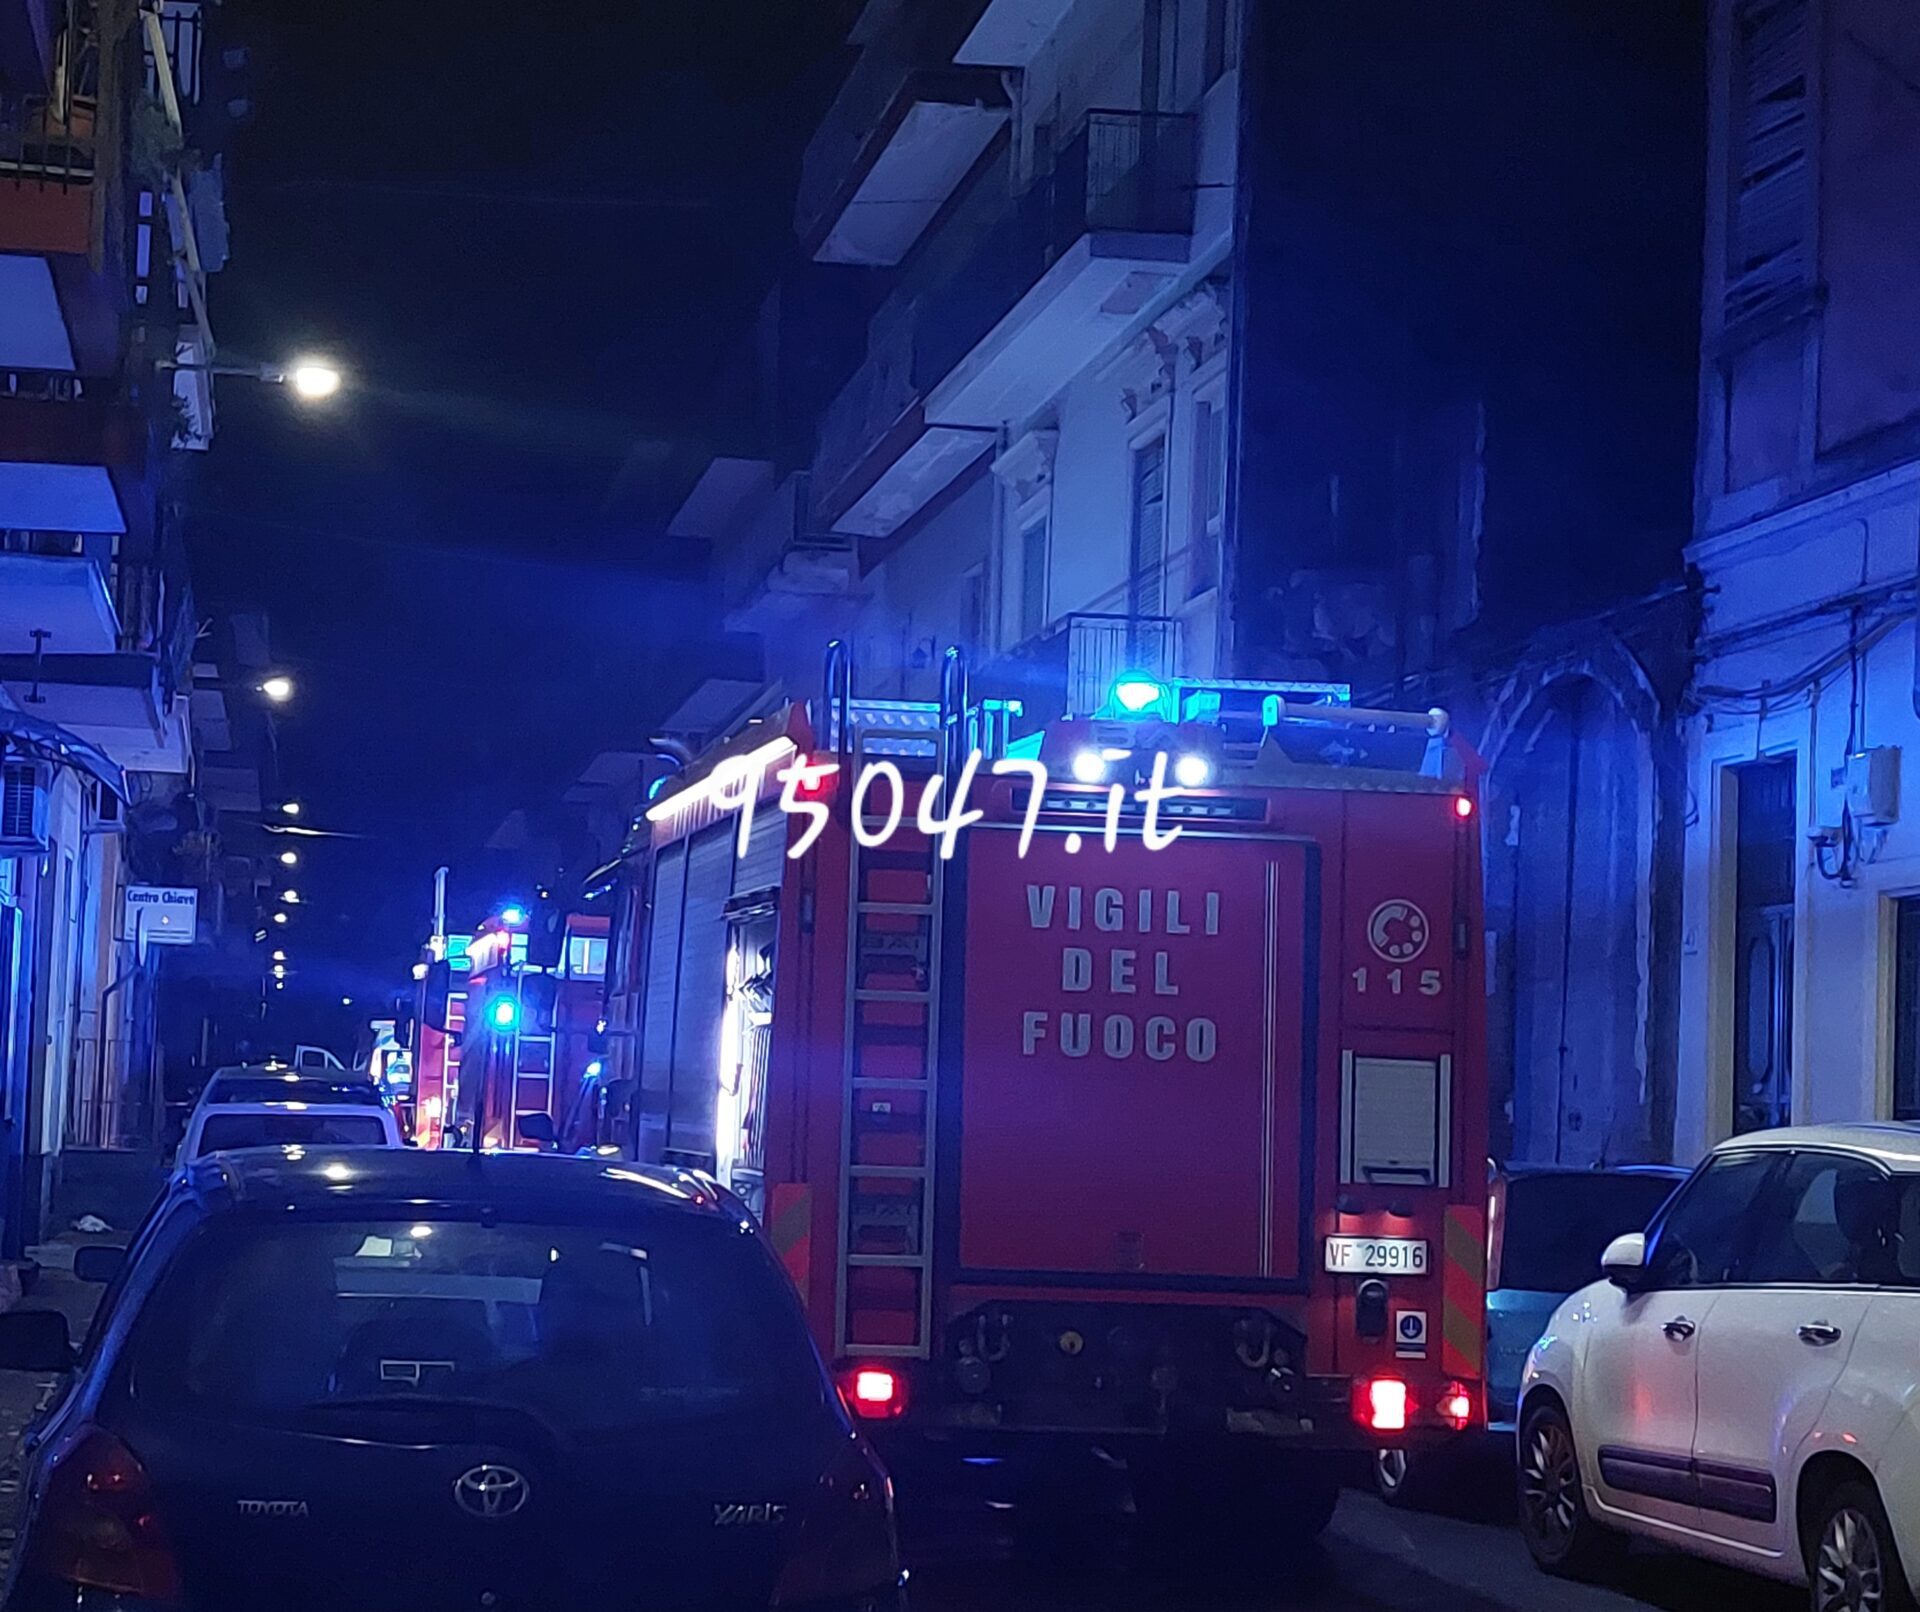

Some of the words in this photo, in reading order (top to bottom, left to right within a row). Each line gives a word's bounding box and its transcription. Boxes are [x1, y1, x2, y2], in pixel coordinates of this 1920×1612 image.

[127, 889, 159, 903] Centro
[1027, 885, 1219, 935] VIGILI
[1062, 947, 1179, 995] DEL
[1352, 967, 1441, 996] 115
[1023, 1011, 1216, 1062] FUOCO
[1330, 1243, 1352, 1266] VF
[1365, 1244, 1423, 1268] 29916
[237, 1500, 309, 1517] TOYOTA
[714, 1502, 787, 1526] YARIS
